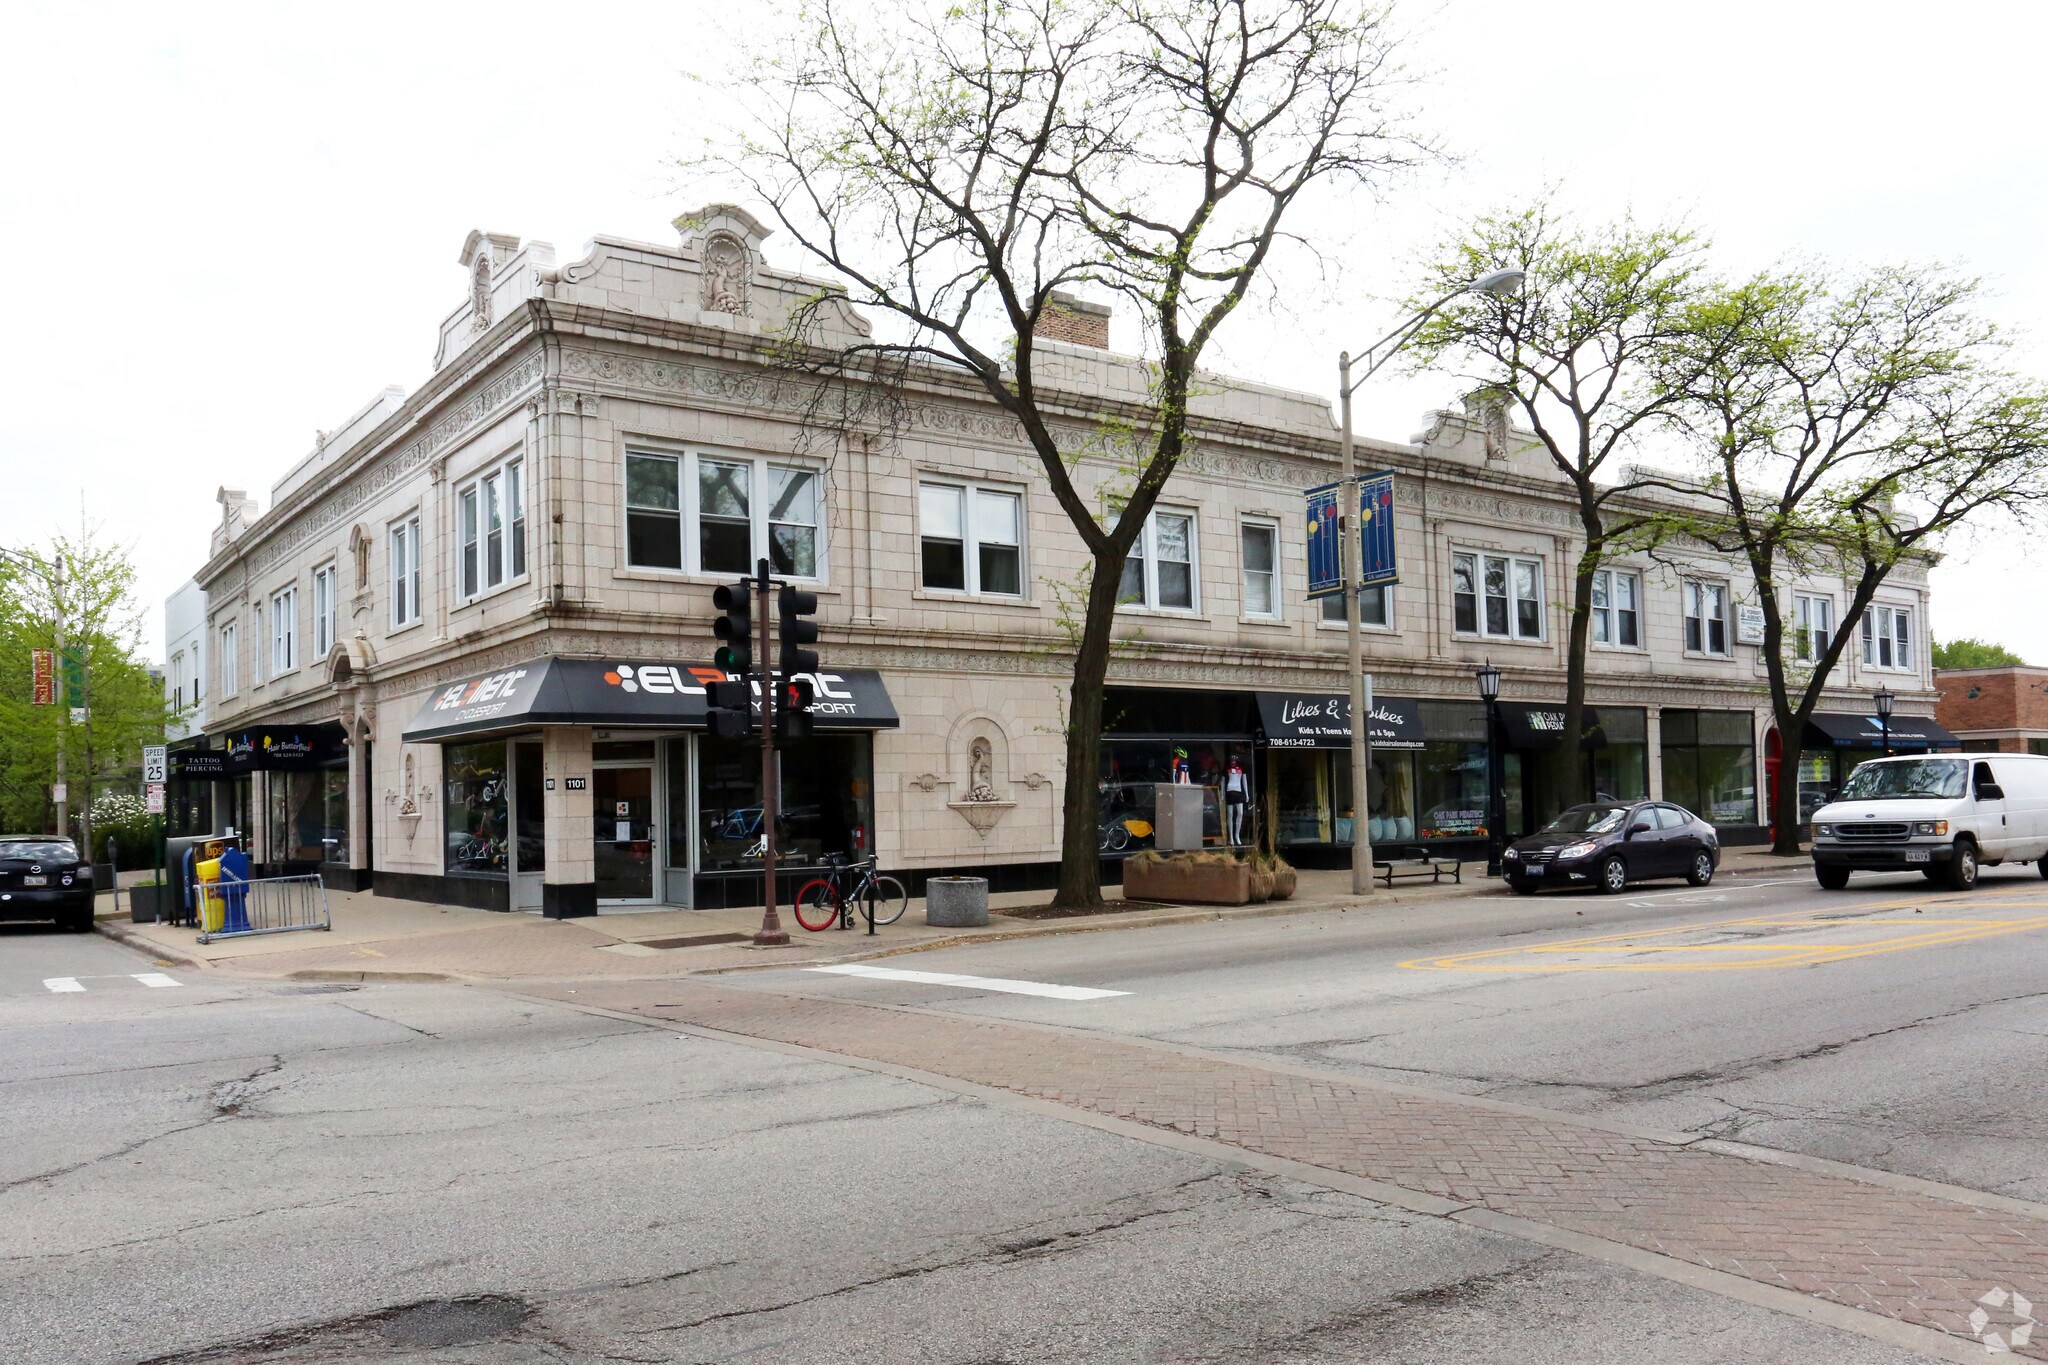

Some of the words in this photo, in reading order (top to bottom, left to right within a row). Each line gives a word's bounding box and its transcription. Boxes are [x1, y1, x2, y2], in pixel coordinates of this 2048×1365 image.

[455, 702, 507, 721] CYCLESPORT
[1282, 700, 1320, 724] Lilies
[1326, 699, 1340, 719] &
[1298, 727, 1314, 735] Kids
[1321, 727, 1342, 735] Teens
[1383, 729, 1396, 737] Spa
[1269, 738, 1315, 746] 708-613-4723
[145, 748, 165, 756] SPEED
[267, 744, 280, 754] Hair
[281, 742, 311, 752] Butterflies
[147, 757, 162, 765] LIMIT
[147, 766, 163, 780] 25
[567, 779, 585, 788] 1101
[207, 847, 223, 858] ups
